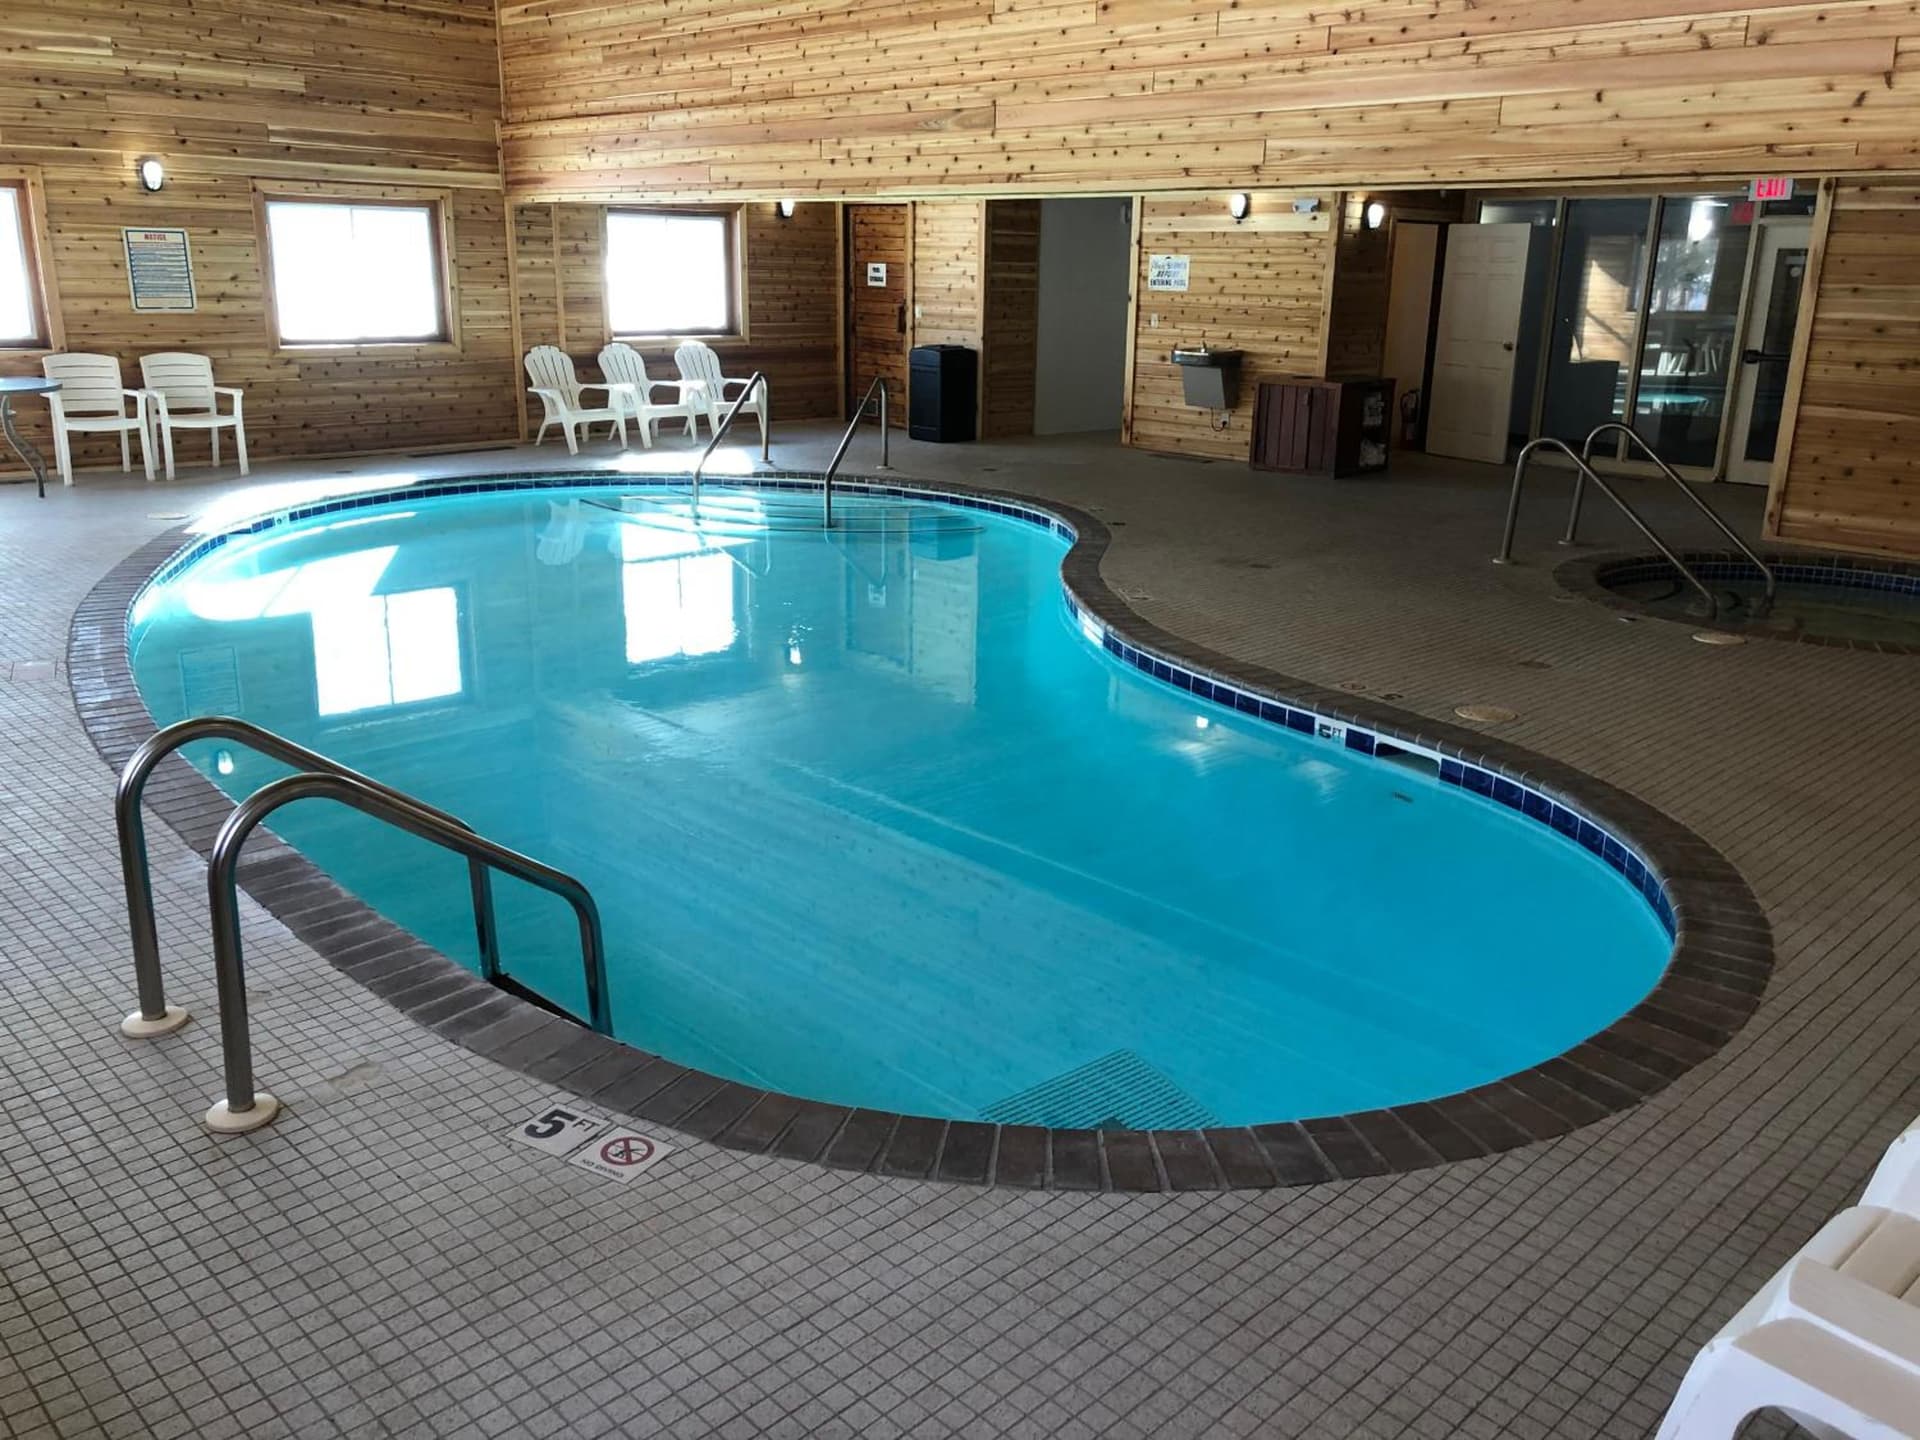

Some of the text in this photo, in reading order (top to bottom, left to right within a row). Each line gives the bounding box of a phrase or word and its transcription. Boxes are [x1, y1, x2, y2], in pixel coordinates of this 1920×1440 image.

[1756, 176, 1786, 198] EXIT
[143, 233, 167, 241] NOTICE
[524, 1109, 601, 1139] 5 FT
[581, 1158, 624, 1178] NO DIVING
